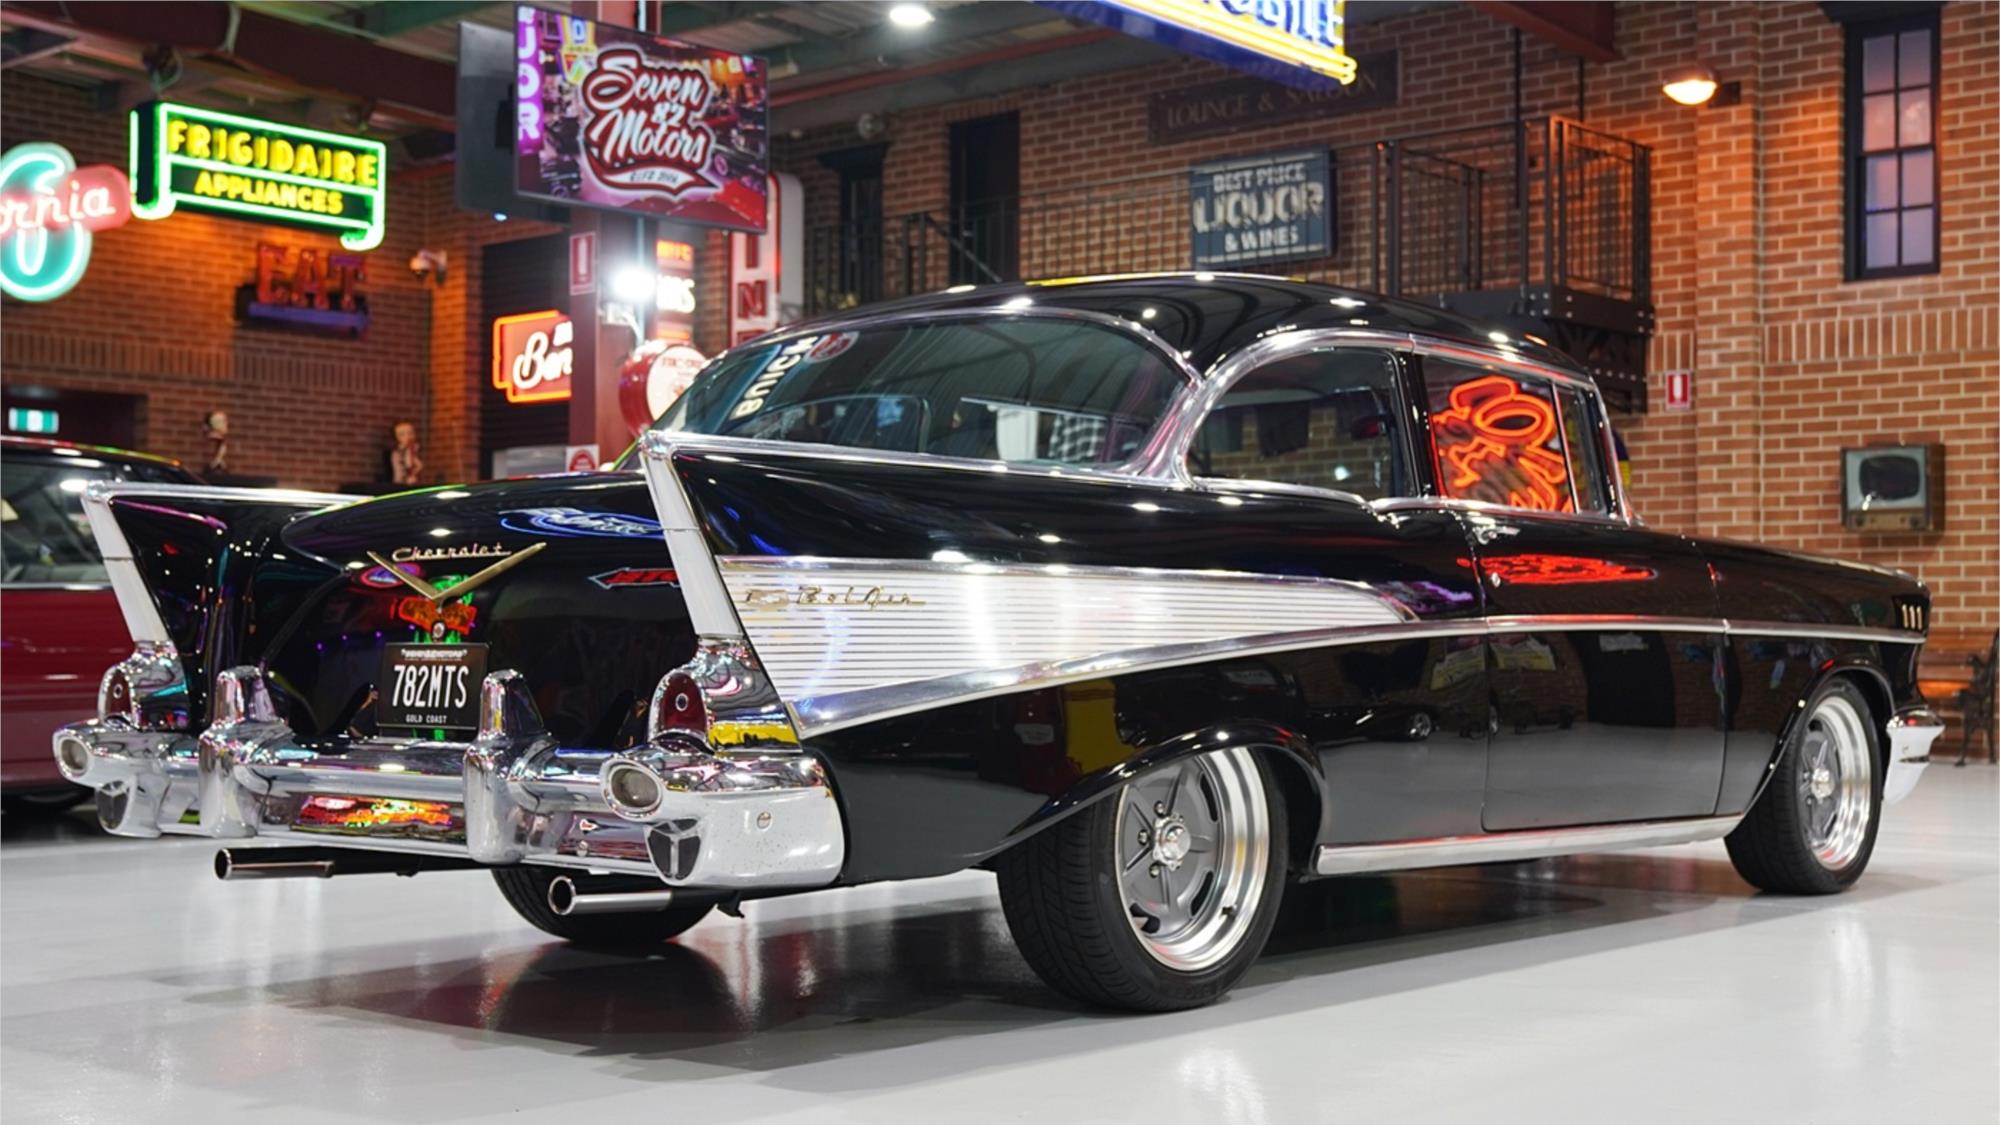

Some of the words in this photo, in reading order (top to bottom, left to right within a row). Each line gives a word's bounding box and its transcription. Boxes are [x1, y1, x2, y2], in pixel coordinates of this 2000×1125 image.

[587, 55, 703, 111] Seven
[650, 101, 685, 127] 82
[1168, 93, 1247, 128] LOUNGE
[1258, 92, 1274, 113] &
[167, 119, 377, 187] FRIGIDAIRE
[590, 109, 707, 164] Motors
[194, 171, 344, 215] APPLIANCES
[1213, 171, 1254, 193] BEST
[1257, 162, 1306, 185] PRICE
[1193, 181, 1324, 234] LIQUOR
[1225, 231, 1238, 253] &
[1242, 226, 1299, 250] WINES
[256, 243, 366, 311] EAT
[392, 542, 512, 562] Chevrolet
[392, 664, 469, 709] 782MTS
[405, 714, 423, 724] GOLD
[426, 714, 448, 724] COAST
